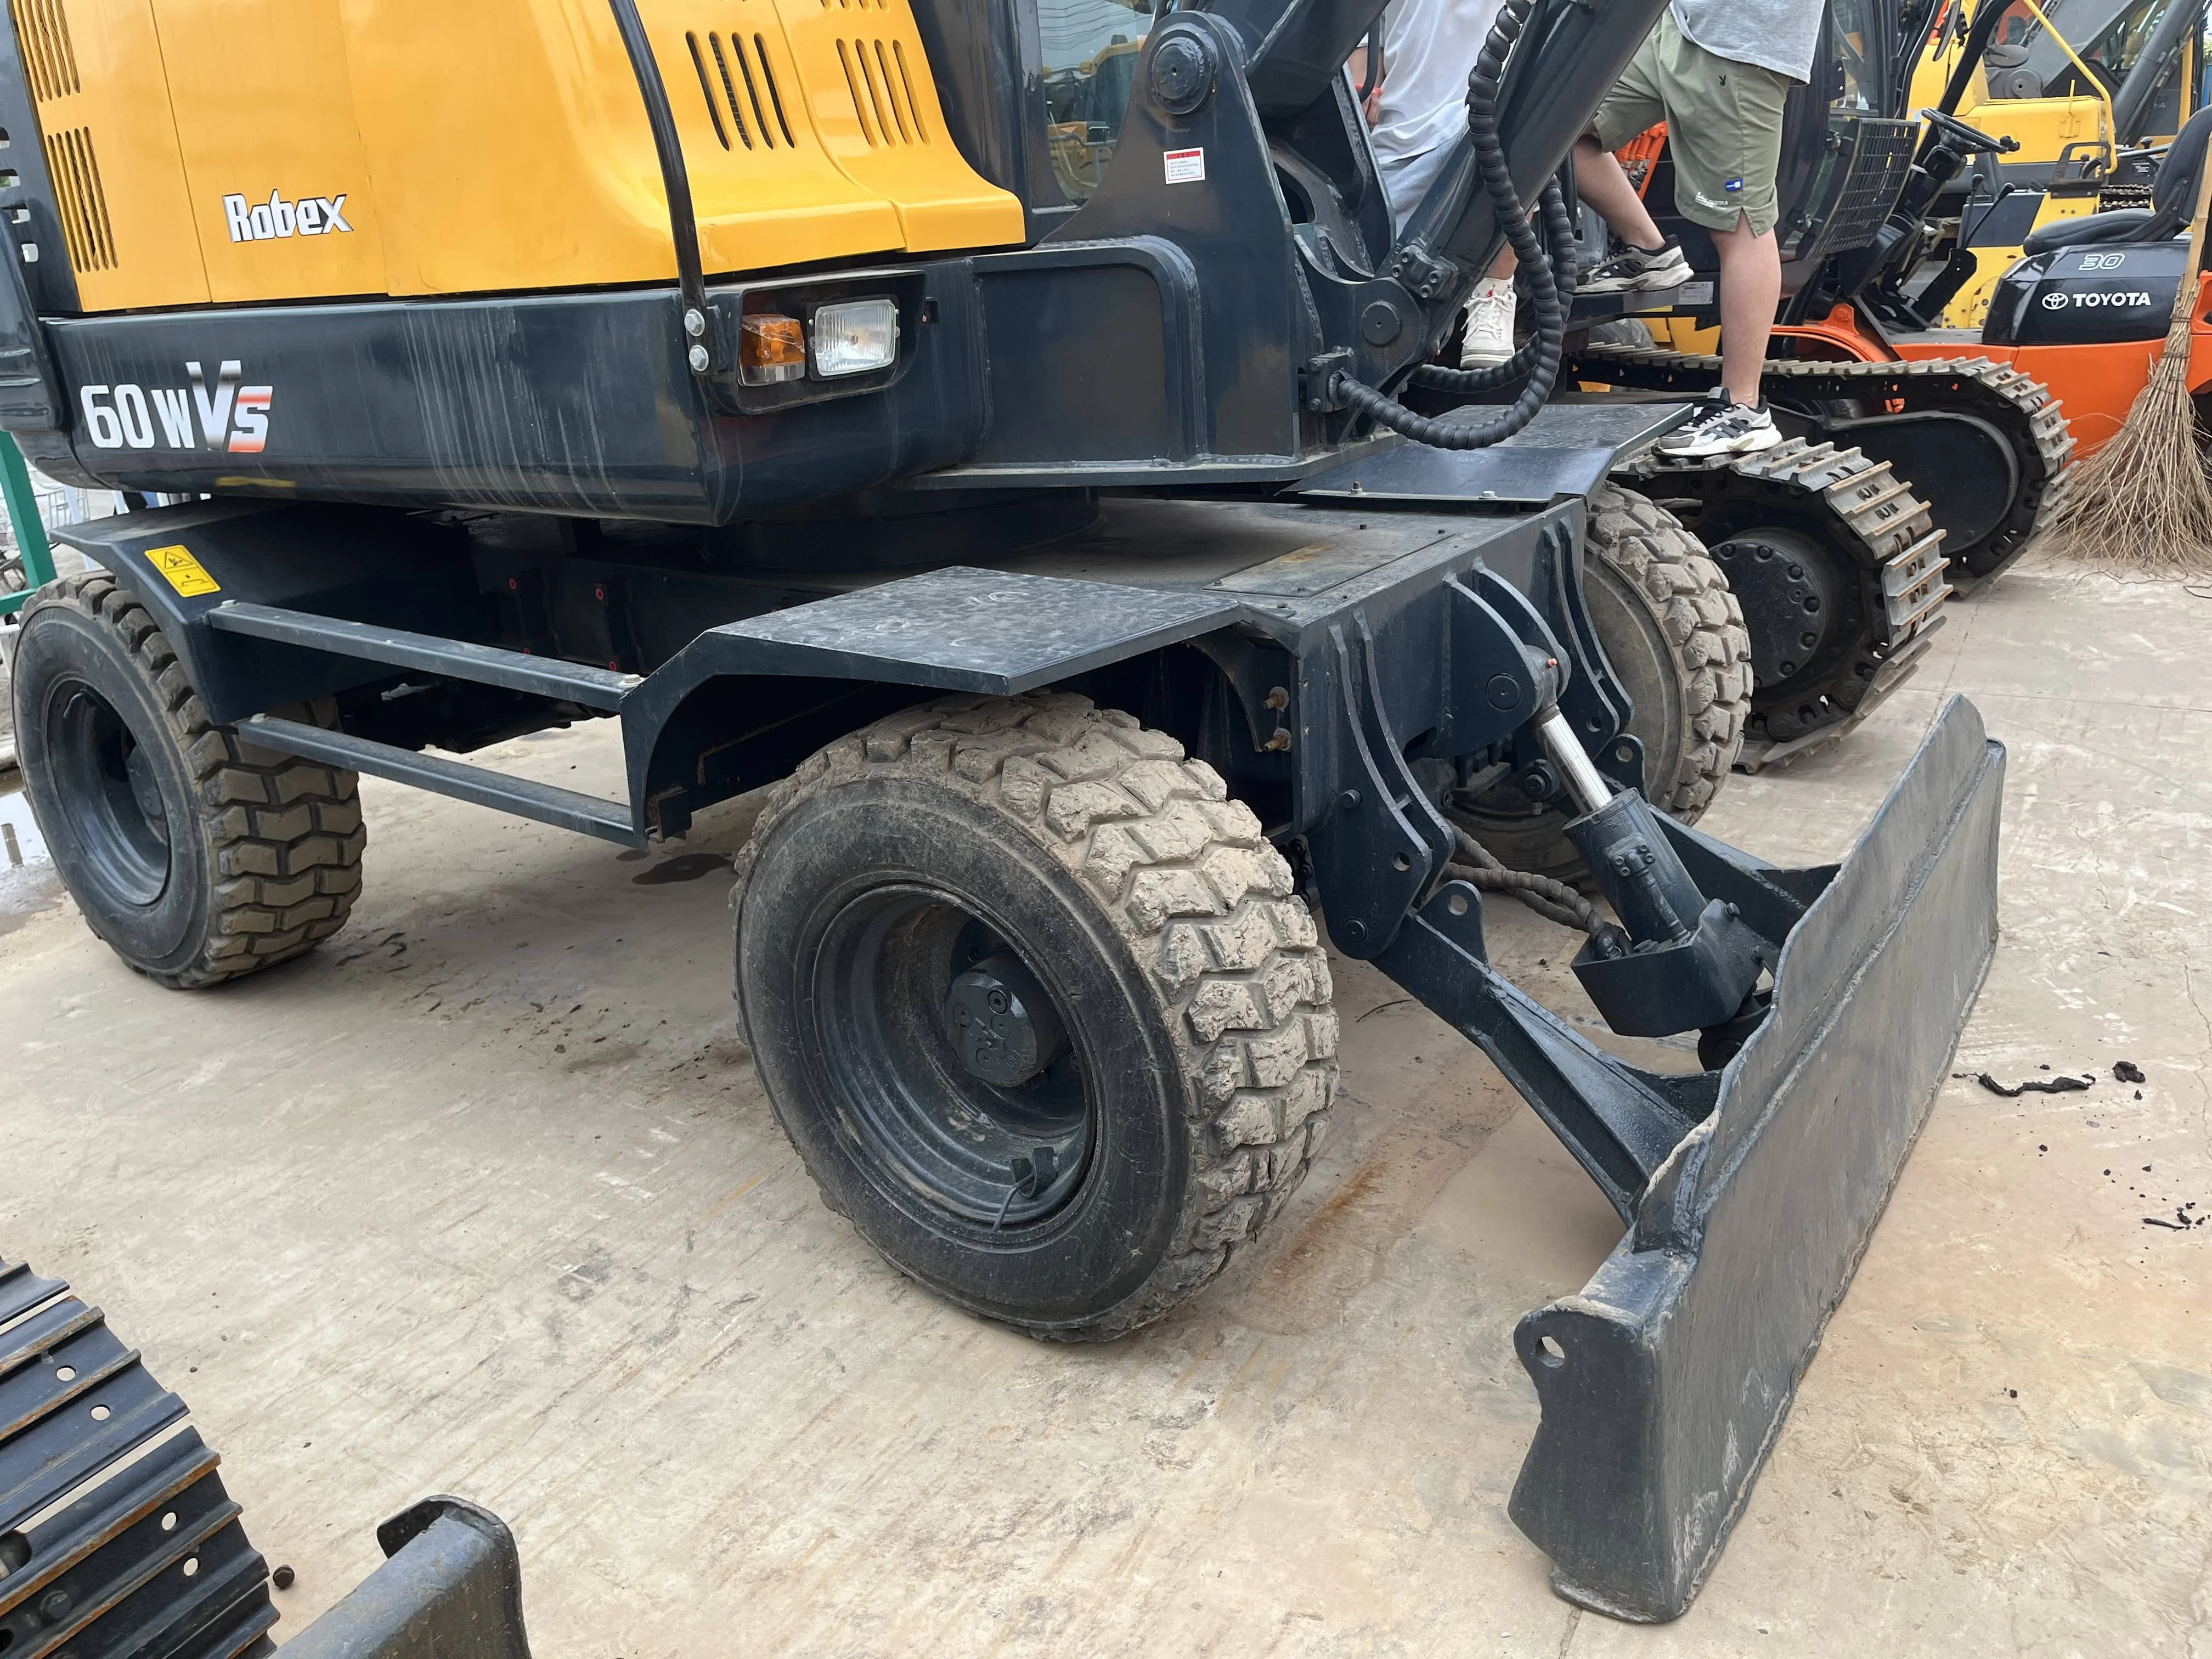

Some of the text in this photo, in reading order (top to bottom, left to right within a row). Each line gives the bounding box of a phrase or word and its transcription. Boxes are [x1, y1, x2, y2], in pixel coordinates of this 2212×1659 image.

[222, 189, 354, 243] Robex
[2078, 253, 2125, 270] 30
[2073, 292, 2151, 307] TOYOTA
